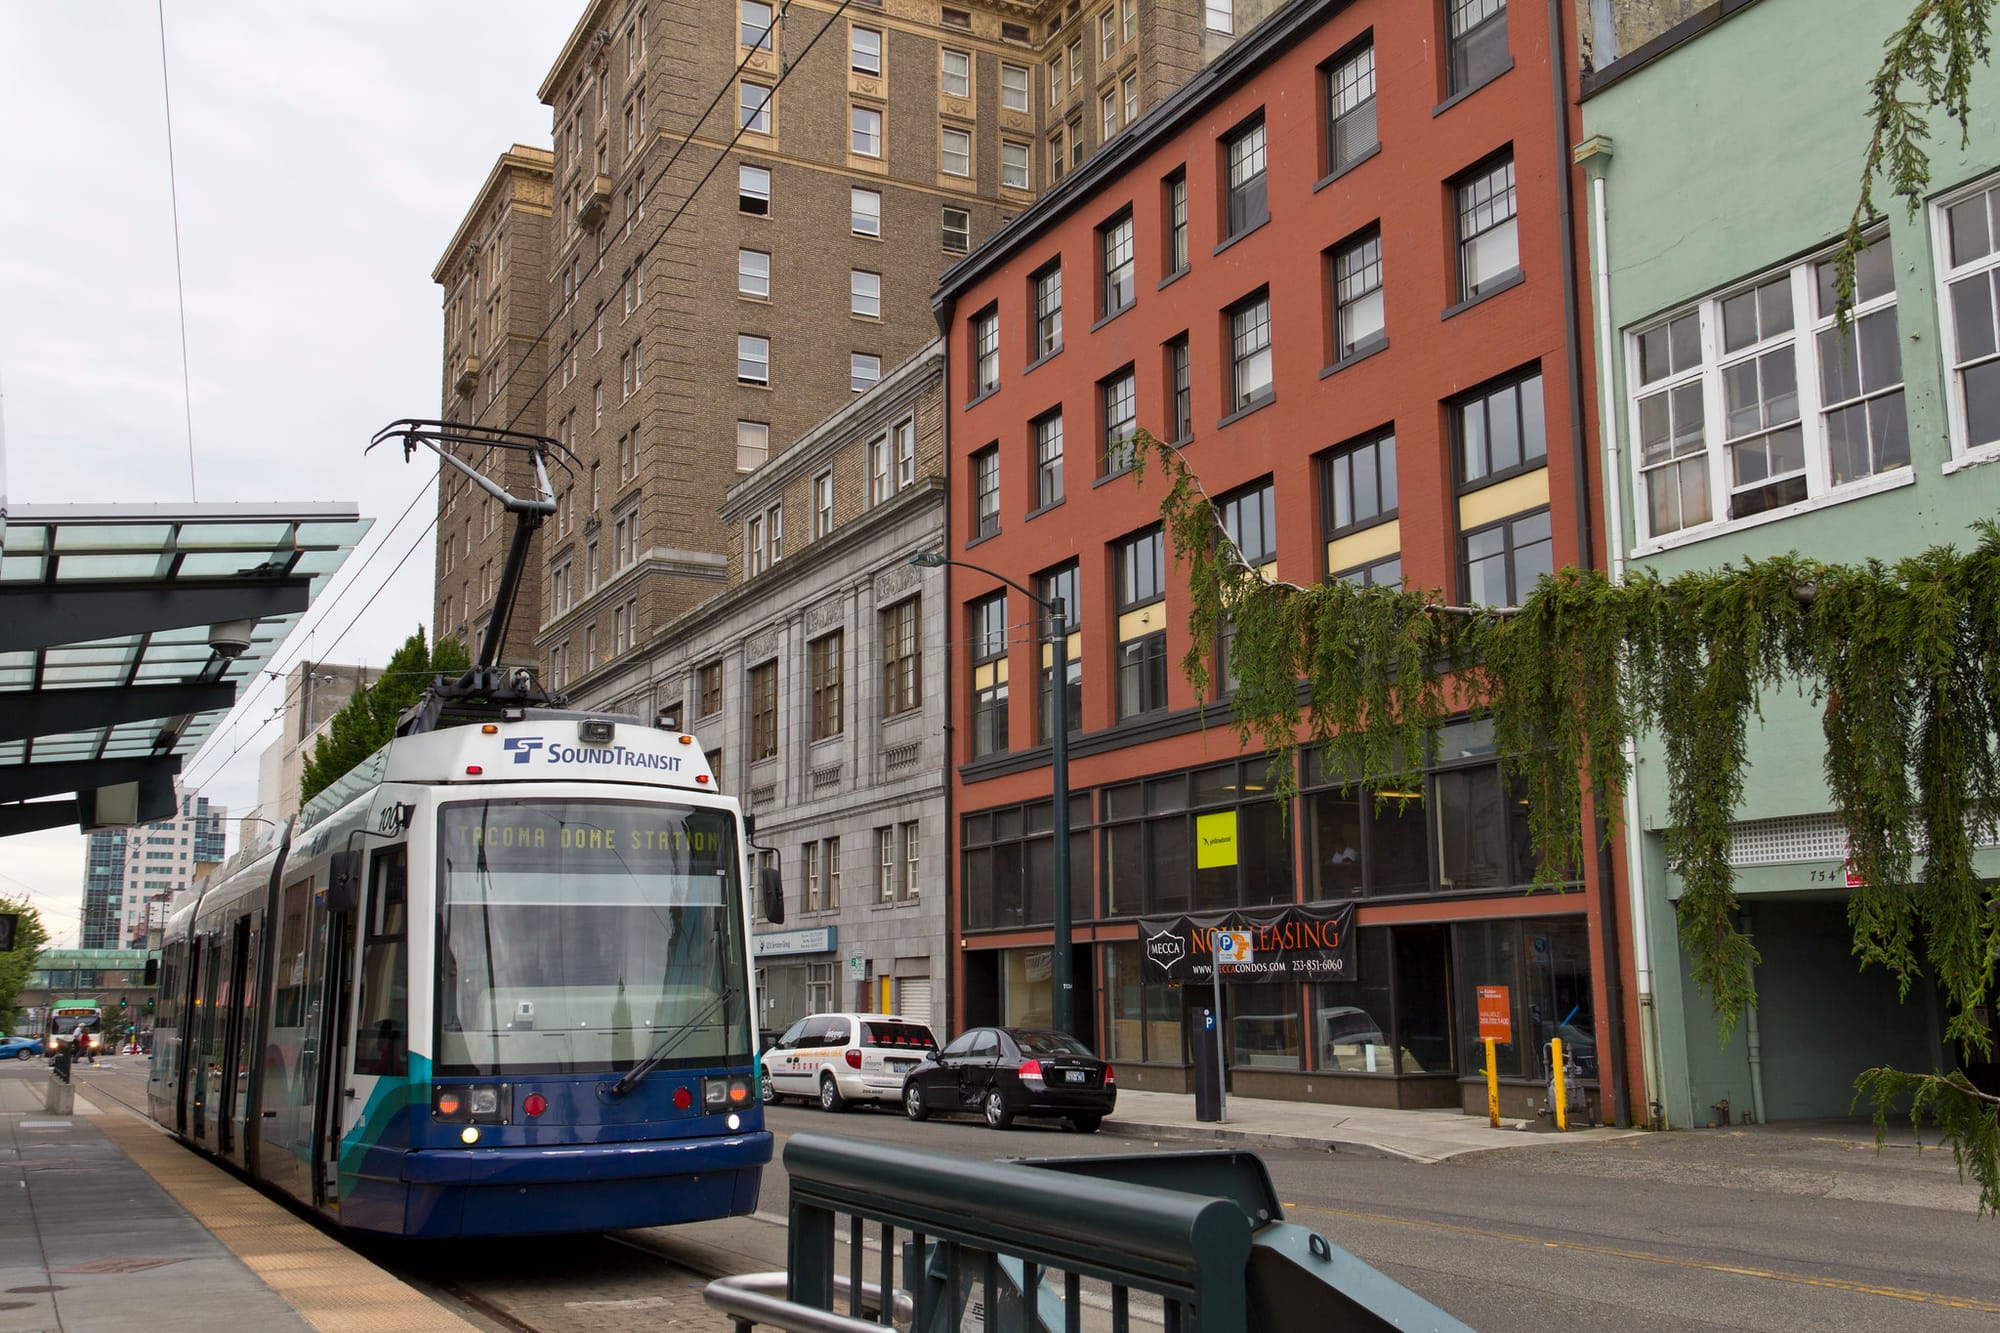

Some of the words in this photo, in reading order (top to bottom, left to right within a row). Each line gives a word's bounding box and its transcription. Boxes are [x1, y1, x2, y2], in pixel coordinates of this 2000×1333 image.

[458, 826, 545, 848] TACOMA
[560, 828, 616, 849] DOME
[631, 830, 719, 852] STATION
[1810, 870, 1836, 882] 754
[1191, 925, 1242, 954] NO
[1248, 920, 1339, 951] LEASING
[1152, 942, 1180, 954] MECCA
[1192, 961, 1286, 974] WWW.ECCACONDOS.COM
[1292, 958, 1343, 972] 253-851-6060
